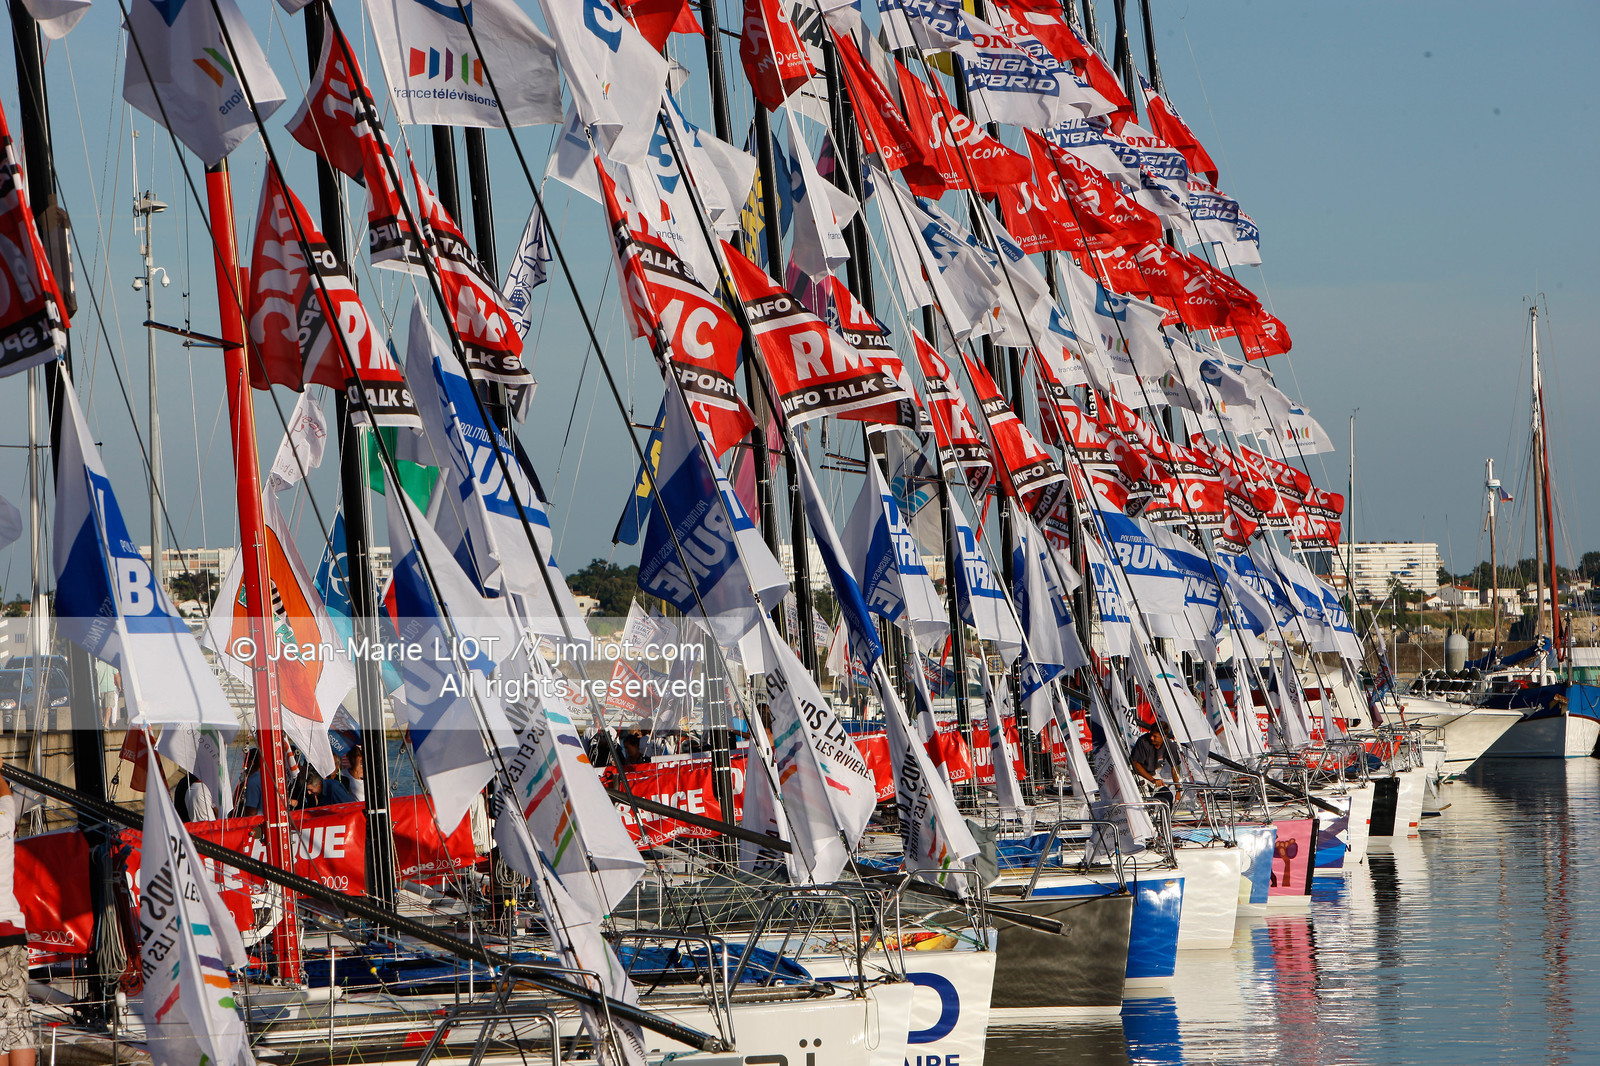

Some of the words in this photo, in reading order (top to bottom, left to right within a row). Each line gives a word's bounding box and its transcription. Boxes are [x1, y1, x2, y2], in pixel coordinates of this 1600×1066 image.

[968, 73, 1057, 92] HYBRID
[824, 378, 877, 401] TALK
[815, 741, 835, 758] LES
[950, 768, 966, 780] 2009
[41, 930, 76, 944] 2009
